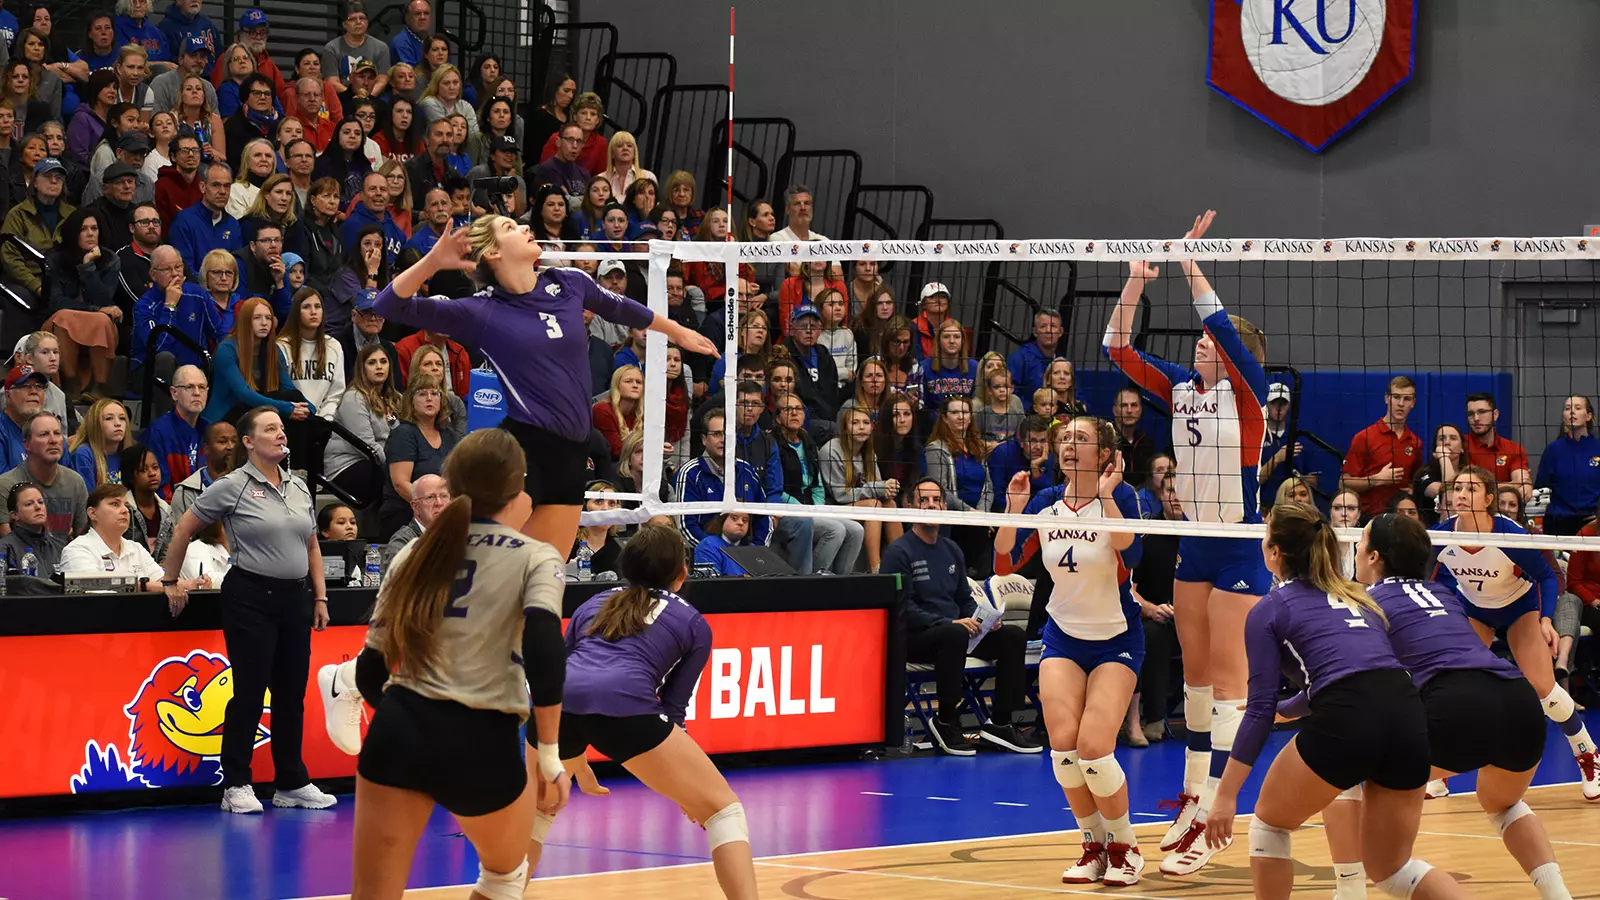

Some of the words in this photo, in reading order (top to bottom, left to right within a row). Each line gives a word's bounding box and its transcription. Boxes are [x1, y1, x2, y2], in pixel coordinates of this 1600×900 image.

[1267, 0, 1356, 54] KU
[192, 37, 204, 45] KU
[503, 135, 516, 144] KU
[739, 244, 782, 257] KANSAS
[808, 242, 853, 255] KANSAS
[881, 242, 926, 255] KANSAS
[954, 242, 1000, 255] KANSAS
[1029, 242, 1075, 254] KANSAS
[1106, 241, 1153, 254] KANSAS
[1184, 240, 1232, 253] KANSAS
[1264, 240, 1313, 253] KANSAS
[1345, 240, 1395, 253] KANSAS
[1429, 240, 1479, 253] KANSAS
[1513, 239, 1566, 253] KANSAS
[538, 311, 564, 339] 3
[727, 300, 735, 341] Schelde
[475, 391, 499, 401] SNA
[1186, 418, 1202, 447] 5
[1047, 529, 1098, 543] KANSAS
[1057, 545, 1079, 574] 4
[1451, 567, 1500, 579] KANSAS
[443, 559, 477, 618] 2
[1402, 583, 1444, 608] 11
[1468, 579, 1485, 592] 7
